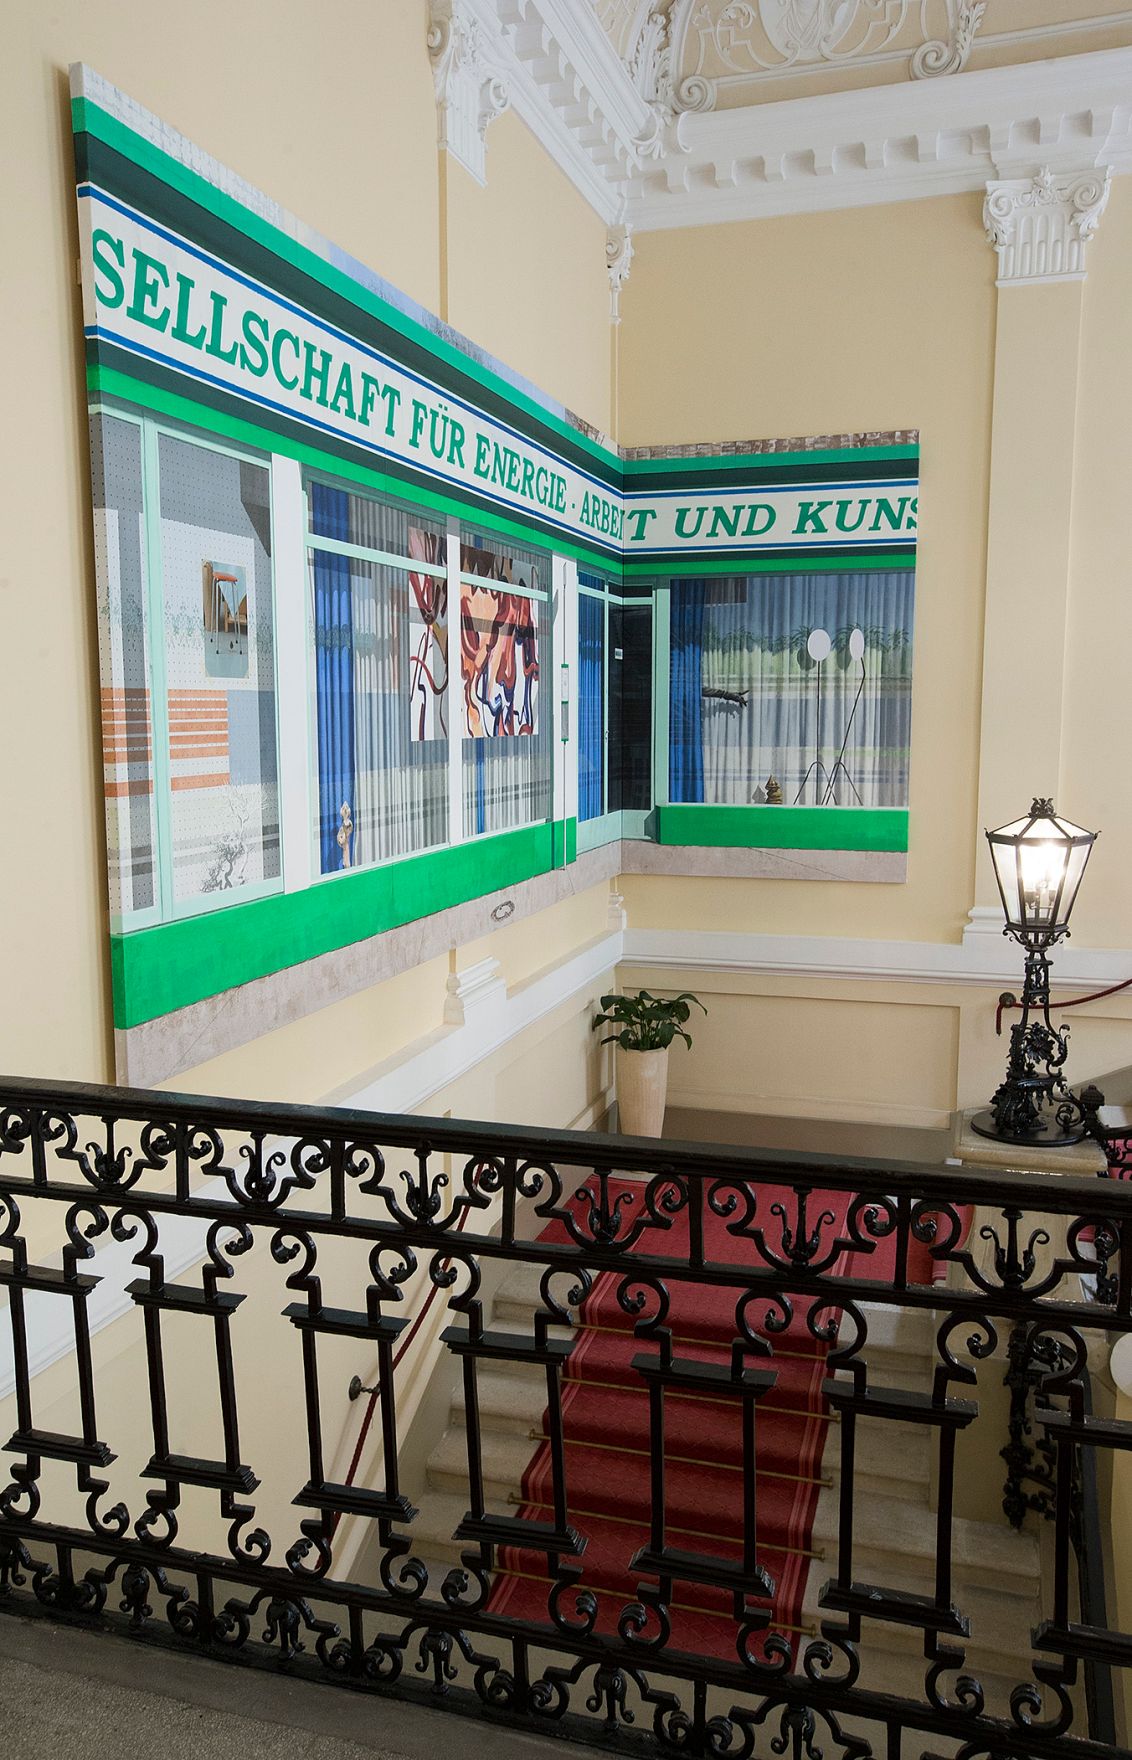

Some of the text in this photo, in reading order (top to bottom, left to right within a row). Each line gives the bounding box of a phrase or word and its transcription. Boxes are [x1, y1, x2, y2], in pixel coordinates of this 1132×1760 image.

[92, 228, 401, 437] SELLSCHAFT
[408, 398, 466, 469] FÜR
[473, 432, 567, 514] ENERGIE
[674, 503, 777, 539] UND
